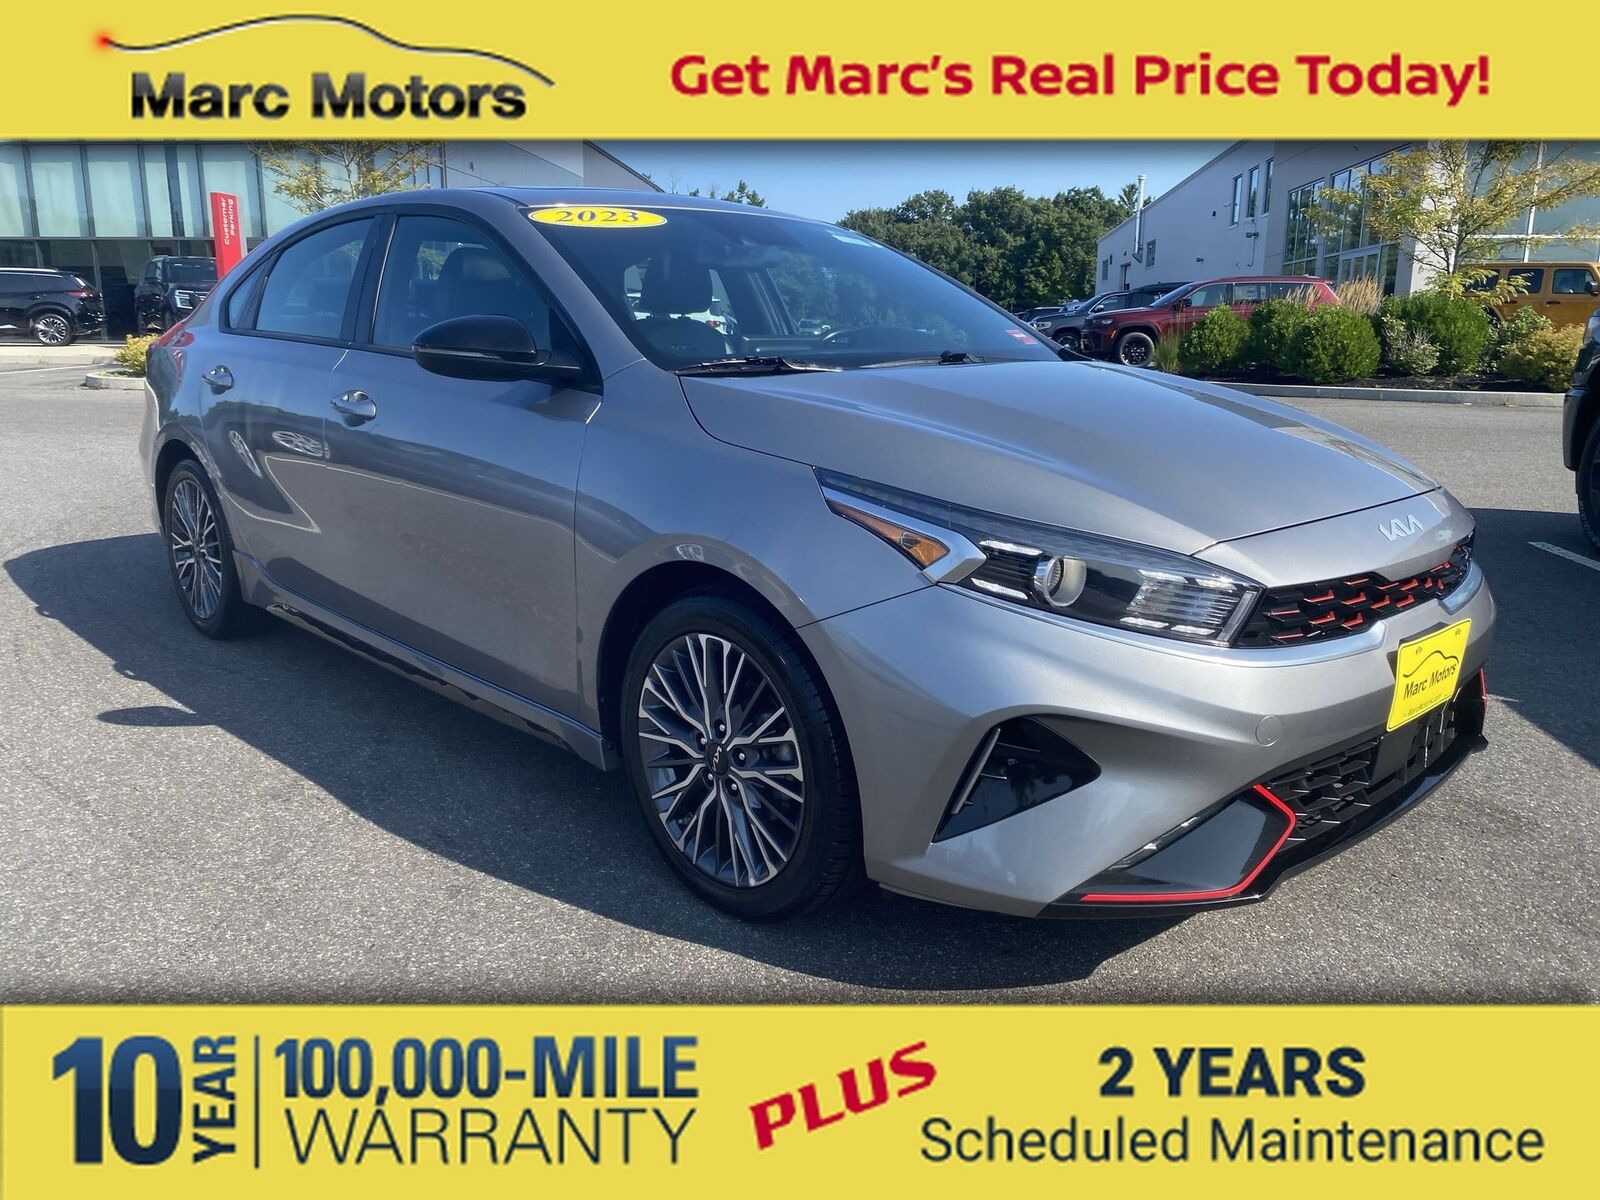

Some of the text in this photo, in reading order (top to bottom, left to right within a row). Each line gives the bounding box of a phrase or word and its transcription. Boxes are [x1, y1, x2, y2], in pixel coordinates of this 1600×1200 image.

[221, 197, 230, 245] Customer
[555, 210, 639, 222] 2023
[1378, 514, 1423, 542] KIA
[1403, 663, 1457, 700] Marc Motors
